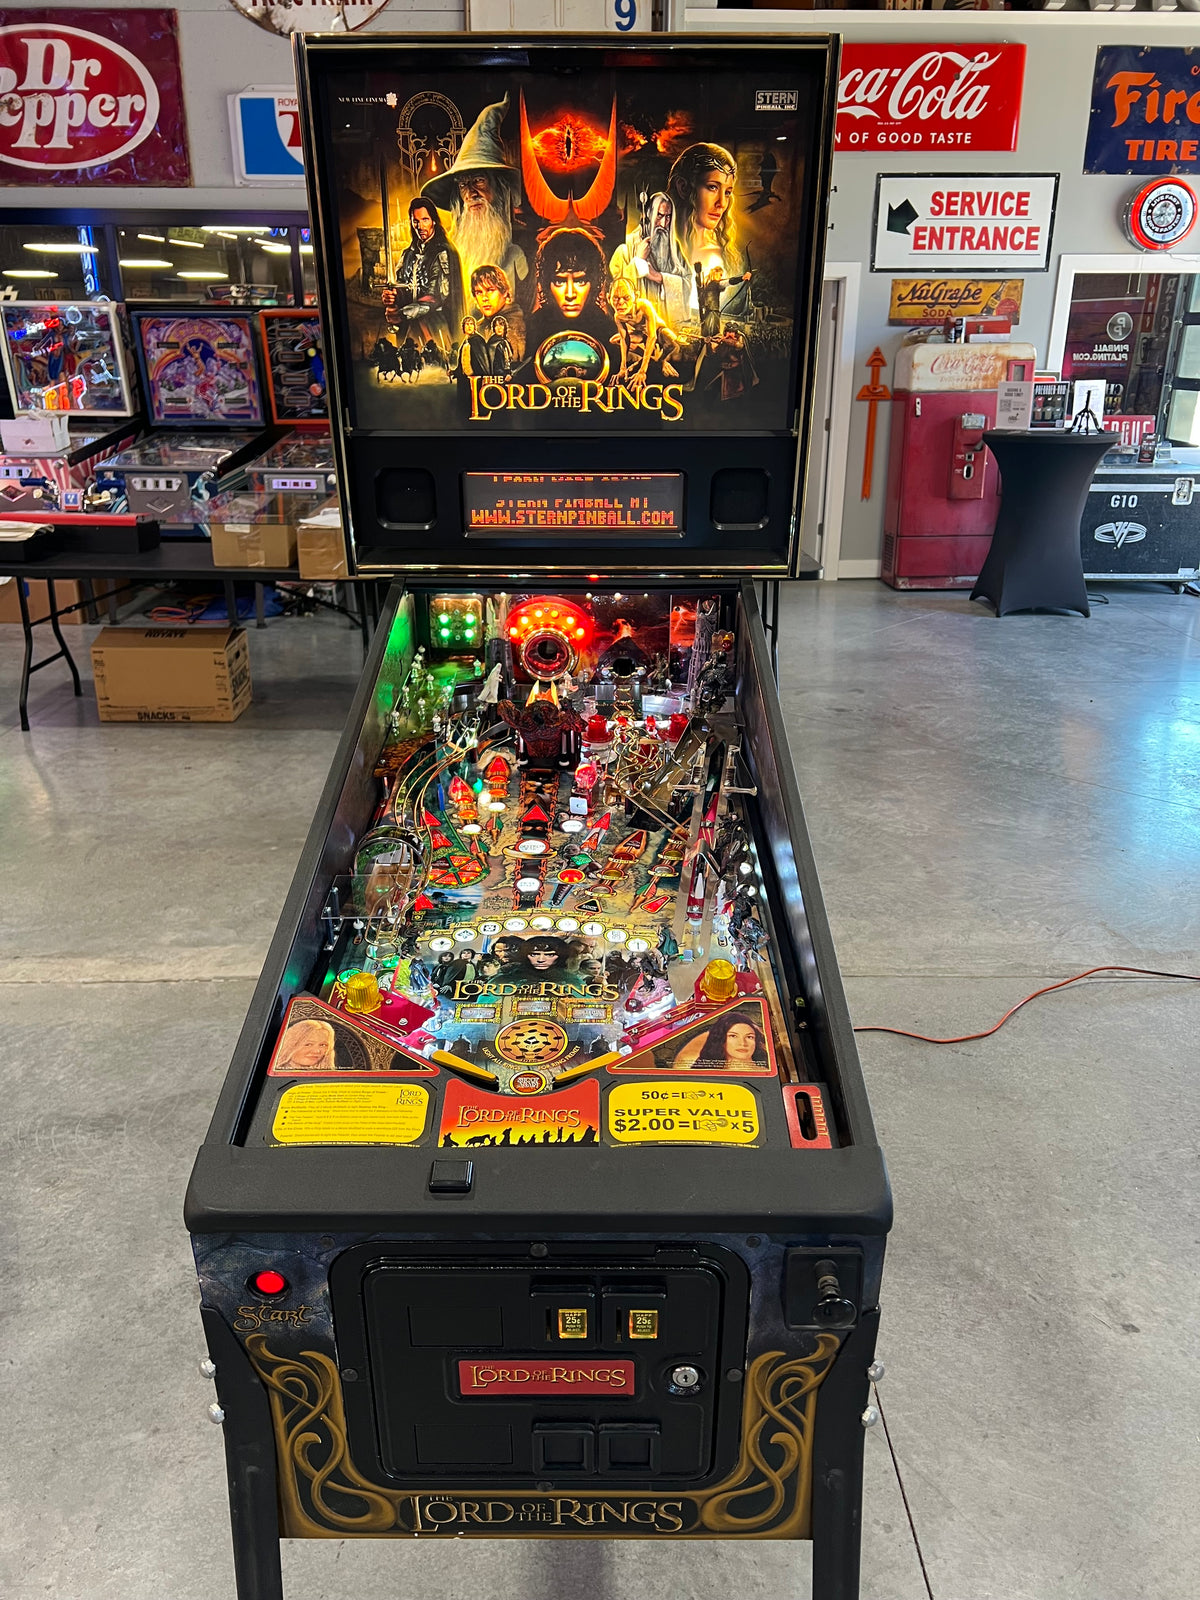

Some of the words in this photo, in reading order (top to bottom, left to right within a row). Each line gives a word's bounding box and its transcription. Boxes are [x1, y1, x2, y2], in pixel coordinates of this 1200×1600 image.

[17, 38, 103, 91] Dr
[838, 51, 1002, 120] ca-Cola
[757, 92, 797, 104] STERN
[849, 132, 869, 144] OF
[877, 132, 923, 144] GOOD
[930, 132, 972, 144] TASTE
[929, 191, 1031, 216] SERVICE
[1151, 195, 1164, 207] LIVE
[1165, 194, 1180, 206] FAST
[912, 226, 1041, 251] ENTRANCE
[897, 281, 983, 308] NuGrape
[922, 308, 953, 318] SODA
[483, 376, 504, 385] THE
[467, 376, 552, 420] LORD
[556, 386, 577, 397] OF
[552, 397, 581, 408] THE
[578, 380, 684, 421] RINGS
[1110, 494, 1138, 508] G10
[471, 509, 674, 525] WWW.STERNPINBALL.COM
[137, 711, 176, 721] SNACKS
[452, 980, 516, 1001] LORD
[538, 982, 619, 1001] RINGS
[400, 1089, 422, 1098] LORD
[395, 1098, 423, 1106] RINGS
[456, 1106, 504, 1127] LORD
[520, 1107, 580, 1128] RINGS
[614, 1108, 681, 1118] SUPER
[694, 1108, 753, 1118] VALUE
[566, 1316, 581, 1324] 25¢
[470, 1365, 531, 1387] LORD
[550, 1367, 627, 1387] RINGS
[409, 1494, 515, 1532] LORD
[522, 1503, 547, 1512] OF
[515, 1511, 551, 1521] THE
[549, 1498, 683, 1532] RINGS
